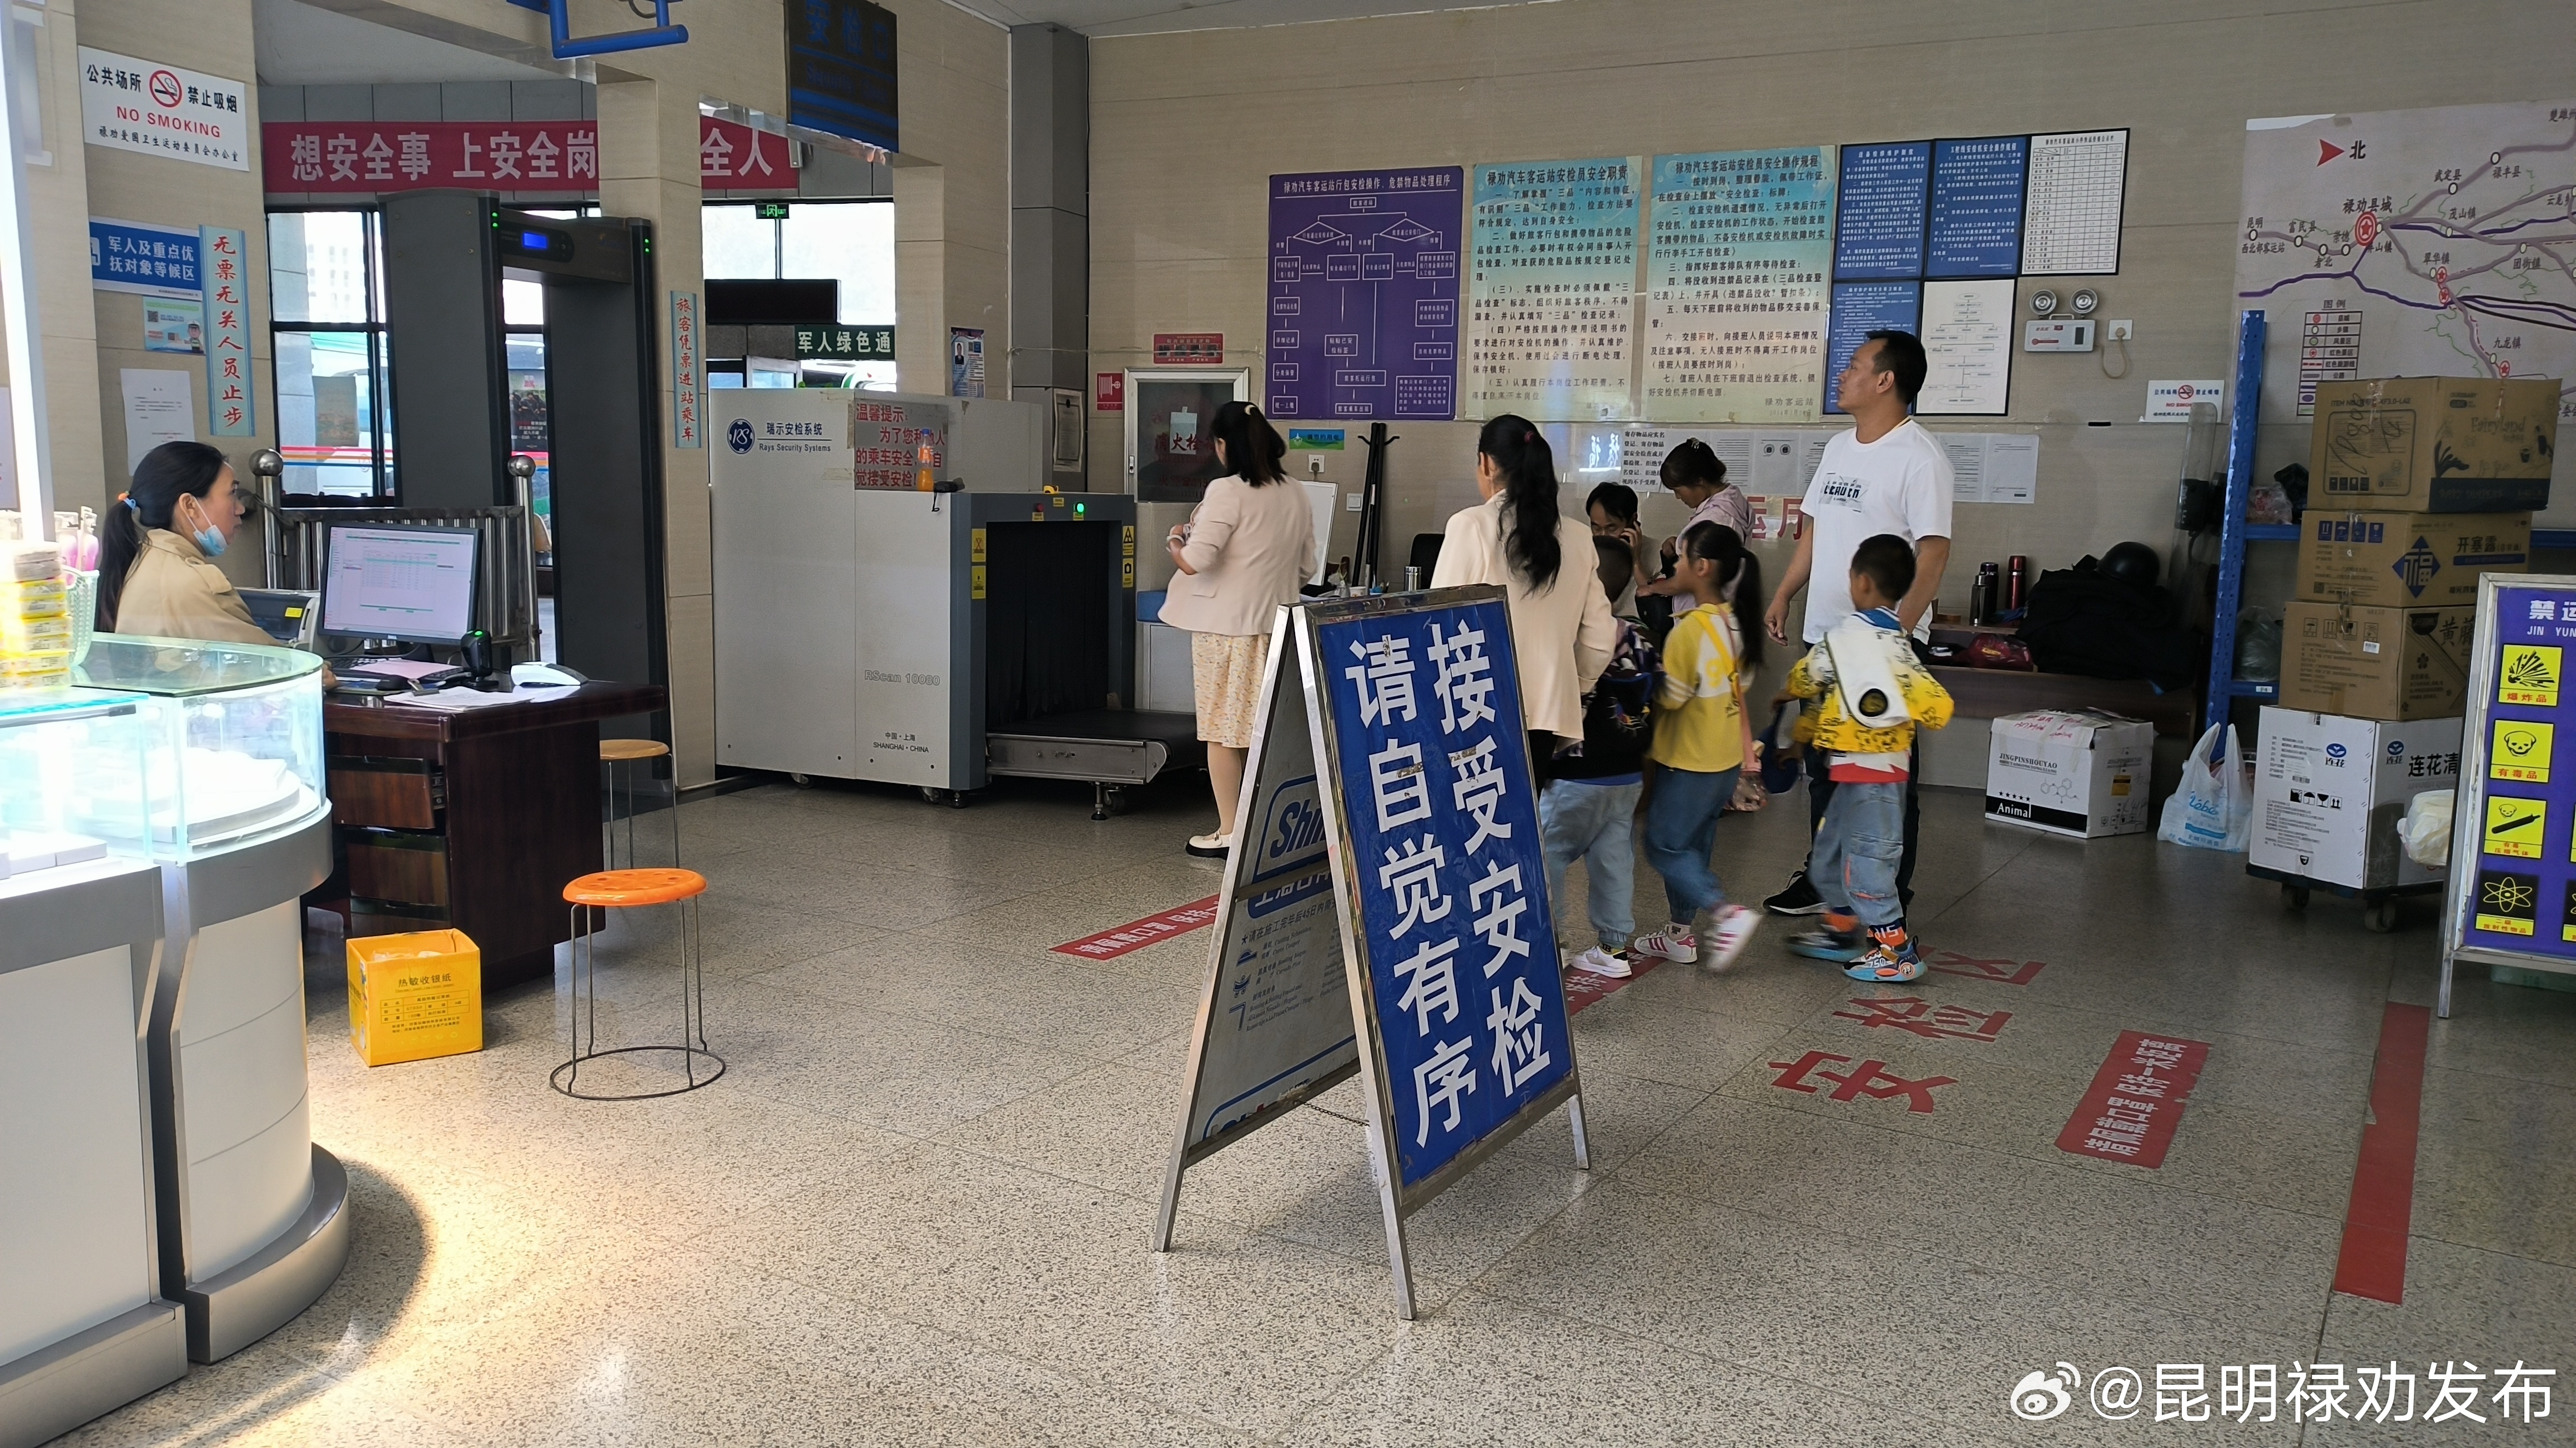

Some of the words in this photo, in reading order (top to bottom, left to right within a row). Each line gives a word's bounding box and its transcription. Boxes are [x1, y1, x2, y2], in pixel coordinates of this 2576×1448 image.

[87, 64, 142, 93] 公共场所
[187, 86, 238, 113] 禁止吸烟
[117, 106, 140, 122] NO
[147, 112, 221, 138] SMOKING
[290, 132, 431, 182] 想安全事
[453, 130, 597, 180] 上安全岗
[2349, 140, 2366, 160] 北
[1487, 164, 1627, 187] 禄劝汽车客运站安检员安全职责
[2434, 169, 2462, 183] 武定县
[2492, 165, 2521, 178] 禄丰县
[2342, 195, 2392, 214] 禄劝县城
[2448, 207, 2476, 220] 茂山镇
[2247, 217, 2263, 228] 昆明
[2288, 220, 2316, 233] 富民县
[108, 235, 194, 262] 军人及重点优
[2242, 242, 2285, 254] 西北部客运站
[2313, 256, 2333, 268] 者北
[2423, 252, 2450, 264] 翠华镇
[2513, 257, 2541, 269] 团街镇
[109, 256, 195, 281] 抚对象等候区
[2323, 299, 2346, 308] 图例
[212, 236, 244, 428] 无票无关人员止步
[798, 330, 892, 353] 军人绿色通
[2494, 336, 2522, 349] 九龙镇
[676, 296, 696, 443] 旅客凭票进站乘车
[766, 421, 823, 436] 瑞示安检系统
[759, 443, 775, 453] Rays
[777, 443, 802, 454] Security
[804, 444, 831, 452] Systems
[2457, 536, 2497, 553] 开塞露
[2527, 626, 2544, 636] JIN
[864, 670, 902, 682] RScan
[905, 673, 940, 686] 10080
[2507, 692, 2547, 703] 爆炸品
[873, 742, 904, 750] SHANGHAI
[1999, 753, 2057, 769] JINGPINSHOUYAO
[2408, 752, 2459, 777] 连花清
[2498, 768, 2538, 780] 有毒品
[1997, 802, 2031, 818] Animal
[1270, 798, 1327, 858] Shi
[1427, 619, 1550, 1098] 接受安检
[2494, 848, 2529, 856] 压缩气体
[1345, 634, 1477, 1148] 请自觉有序
[2483, 923, 2527, 934] 放射性物品
[398, 973, 451, 988] 热敏收银纸
[2114, 1039, 2187, 1098] 保持一米距离
[2084, 1097, 2159, 1156] 请佩戴口罩
